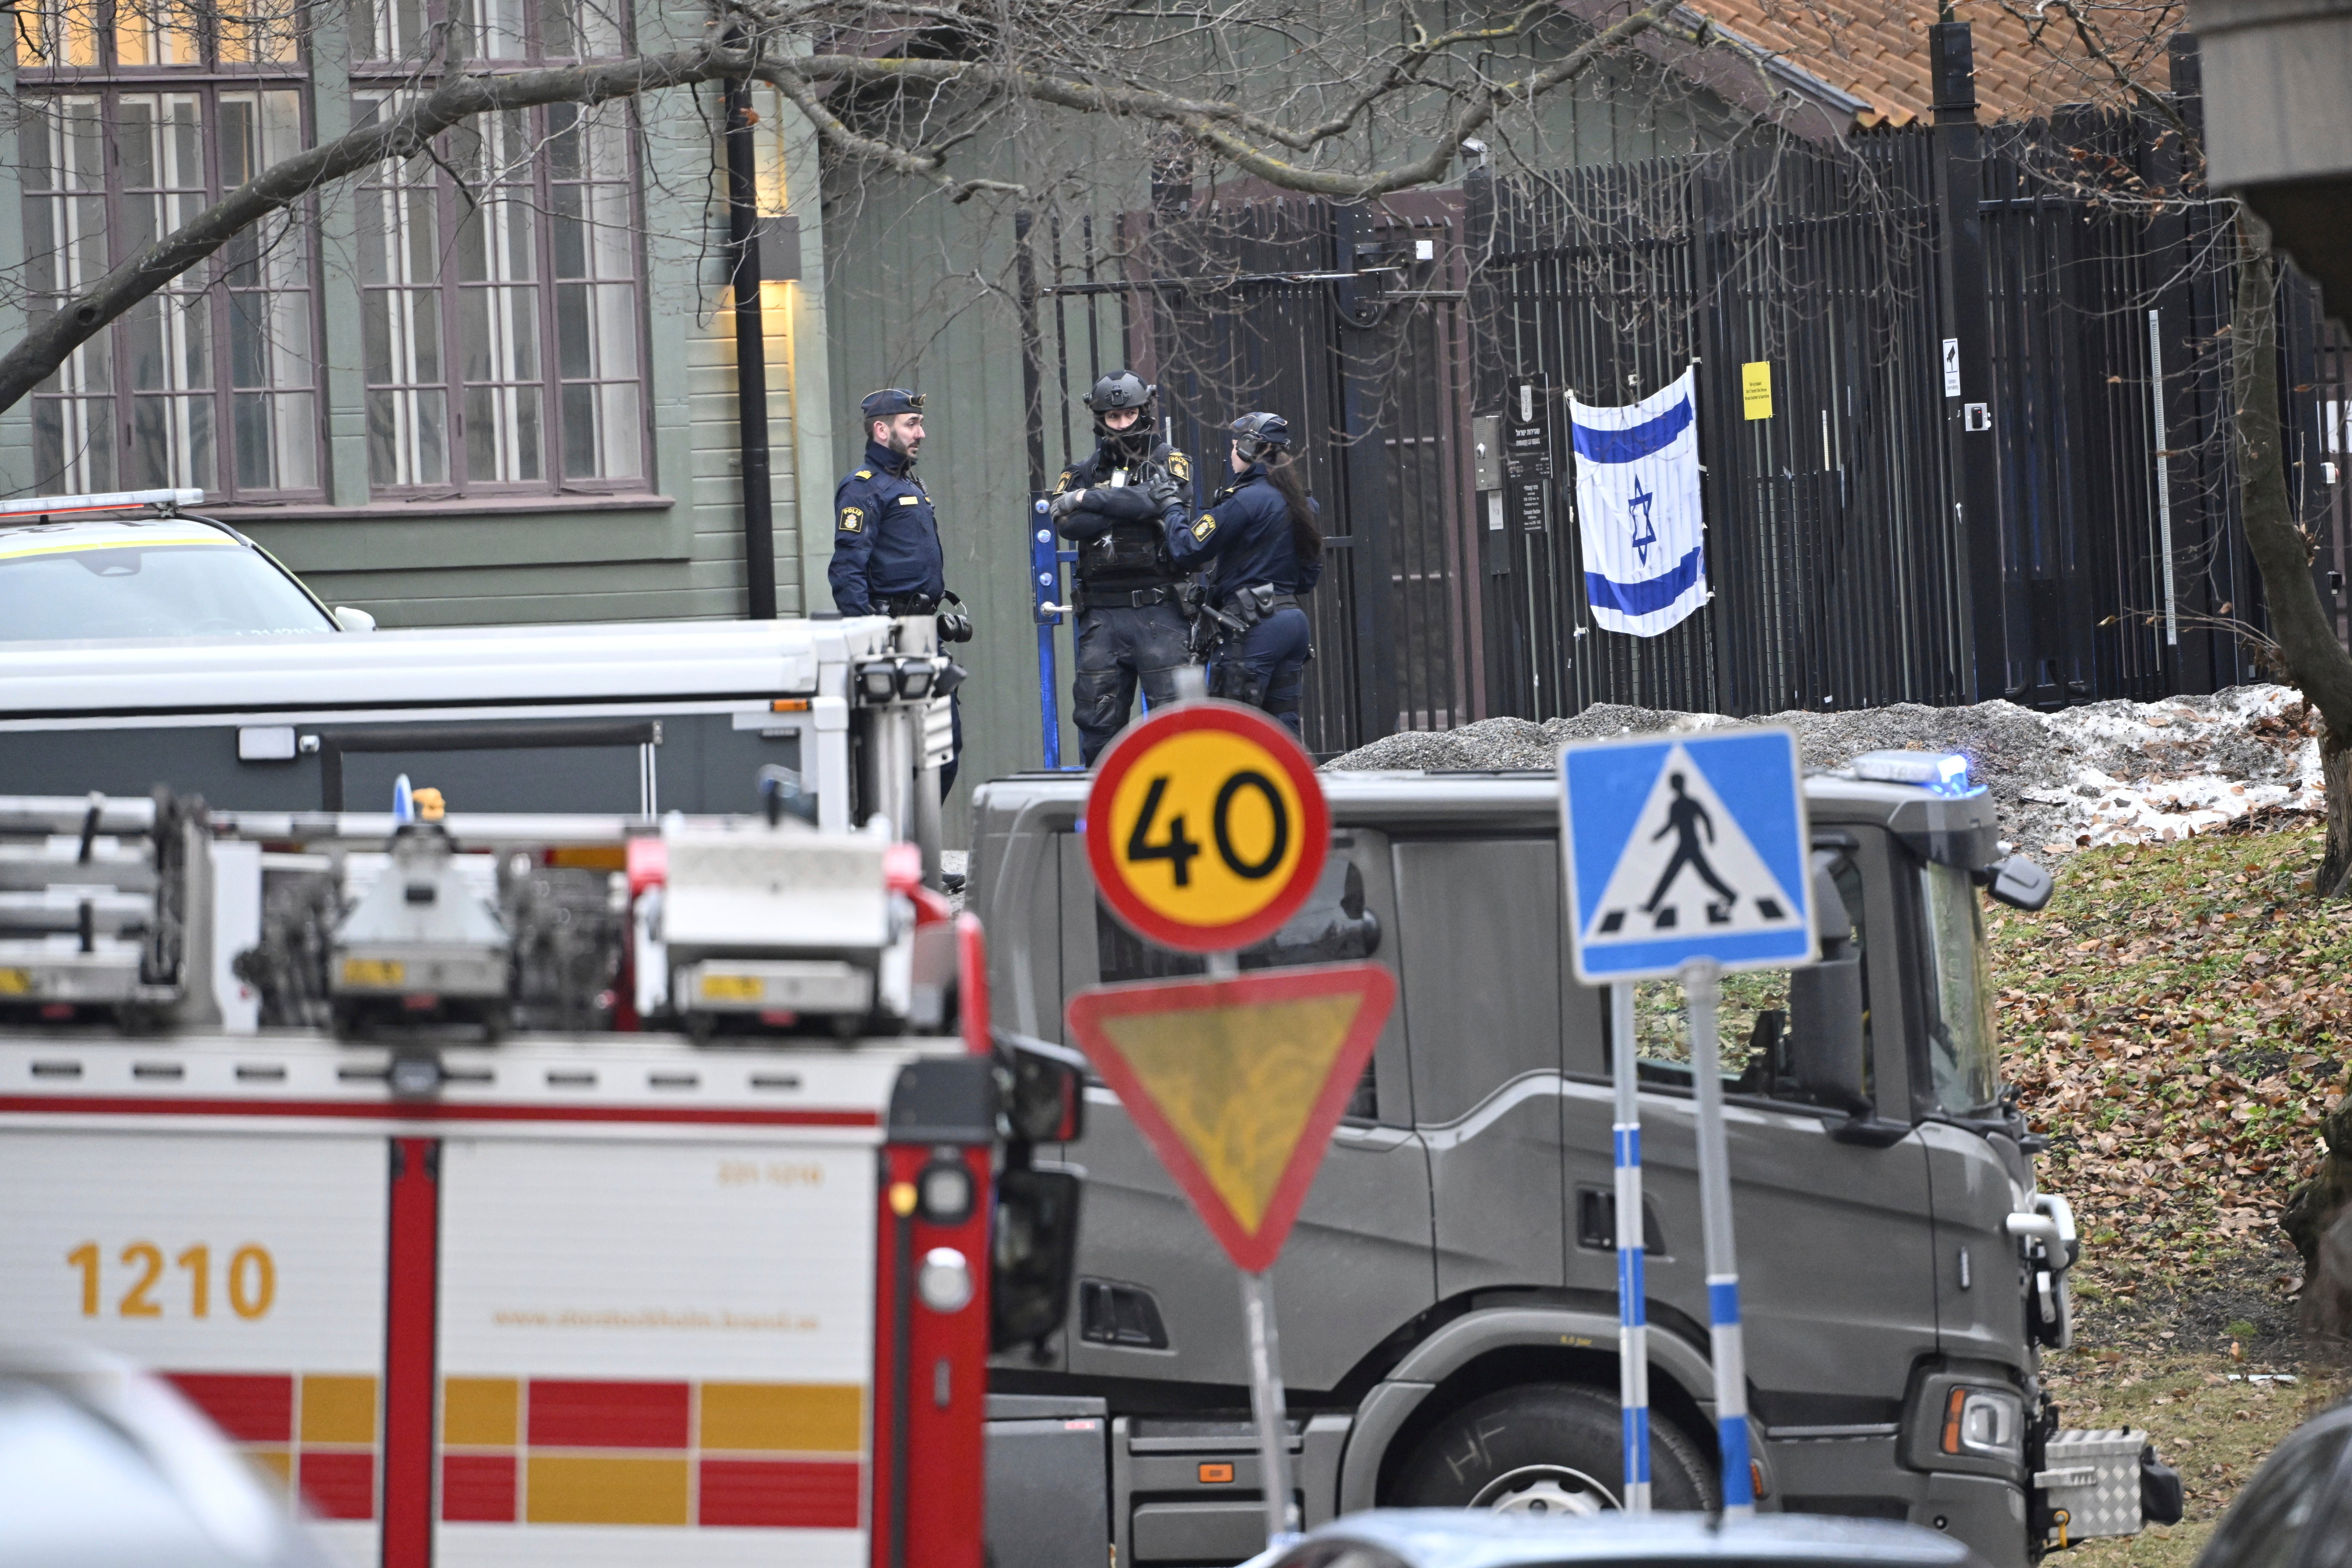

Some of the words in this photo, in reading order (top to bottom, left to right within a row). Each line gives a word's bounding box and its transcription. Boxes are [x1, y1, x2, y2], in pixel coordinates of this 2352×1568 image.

[1171, 457, 1187, 466] POLIS
[1203, 515, 1214, 528] POLIS
[1127, 770, 1288, 887] 40
[67, 1241, 276, 1320] 1210
